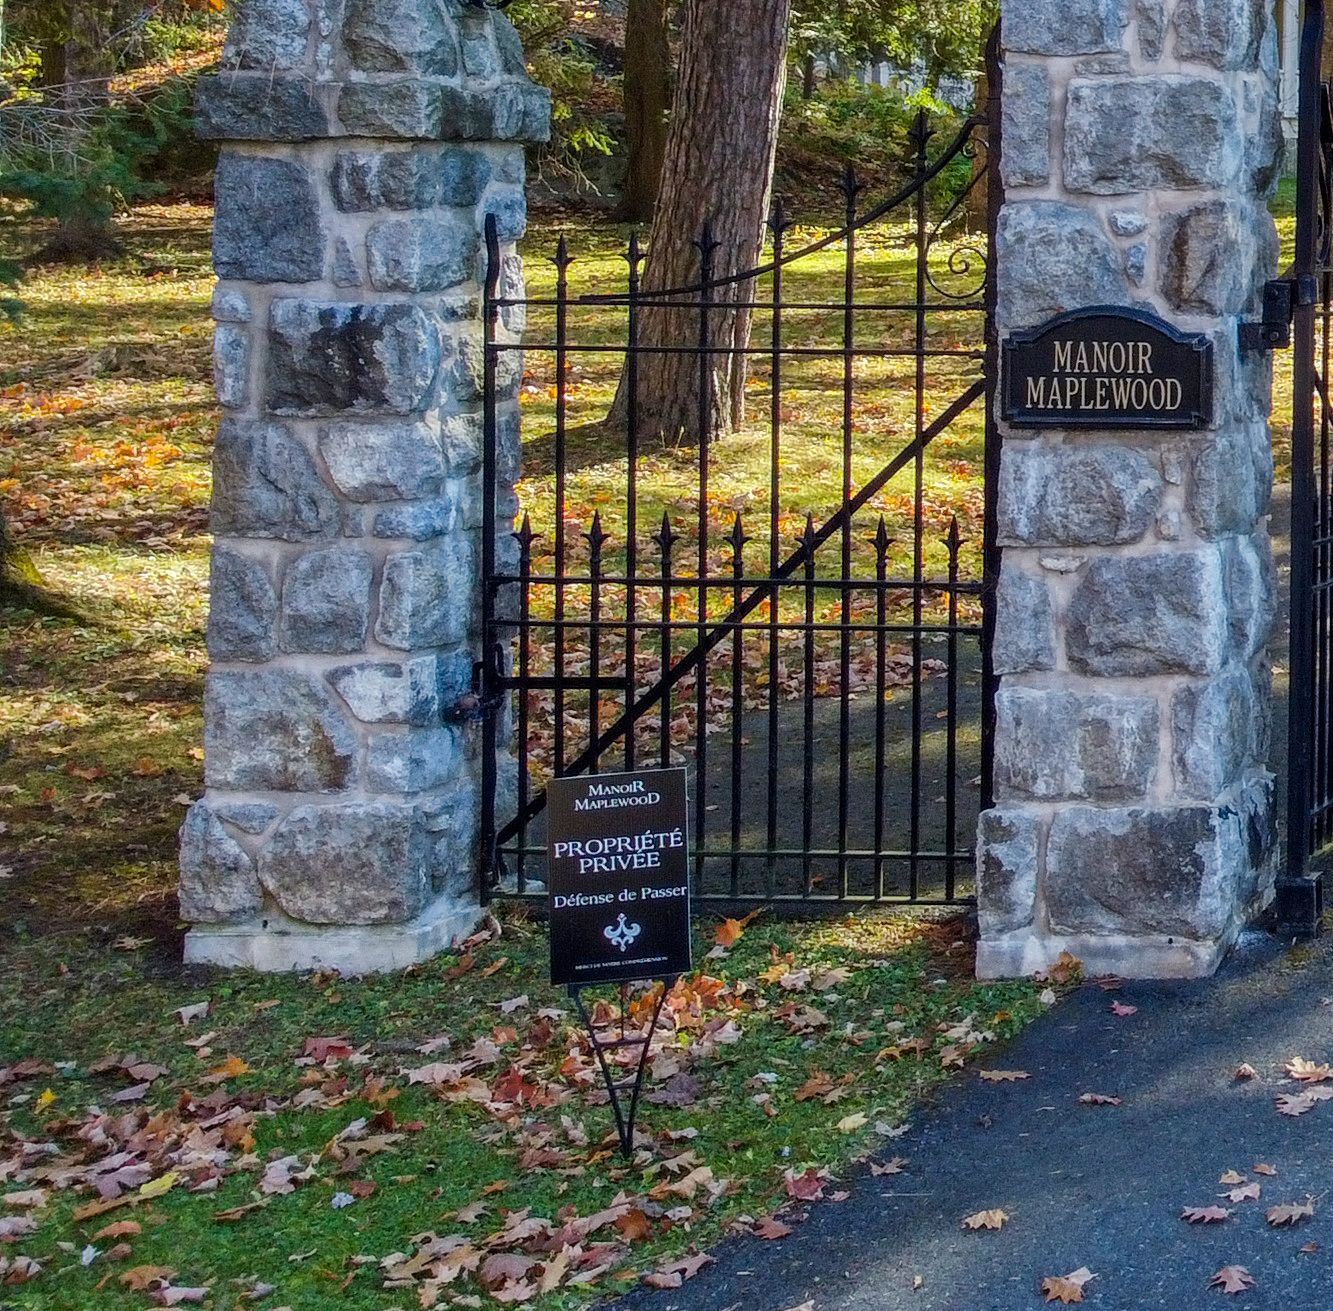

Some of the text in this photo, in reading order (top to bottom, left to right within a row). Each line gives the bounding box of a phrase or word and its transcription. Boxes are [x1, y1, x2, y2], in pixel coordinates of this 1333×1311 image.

[1053, 341, 1153, 374] MANOIR
[1026, 377, 1182, 410] MAPLEWOOD
[554, 828, 684, 859] PROPRIÉTÉ
[580, 849, 661, 874] PRIVÉE
[554, 886, 688, 909] Défense de Passer
